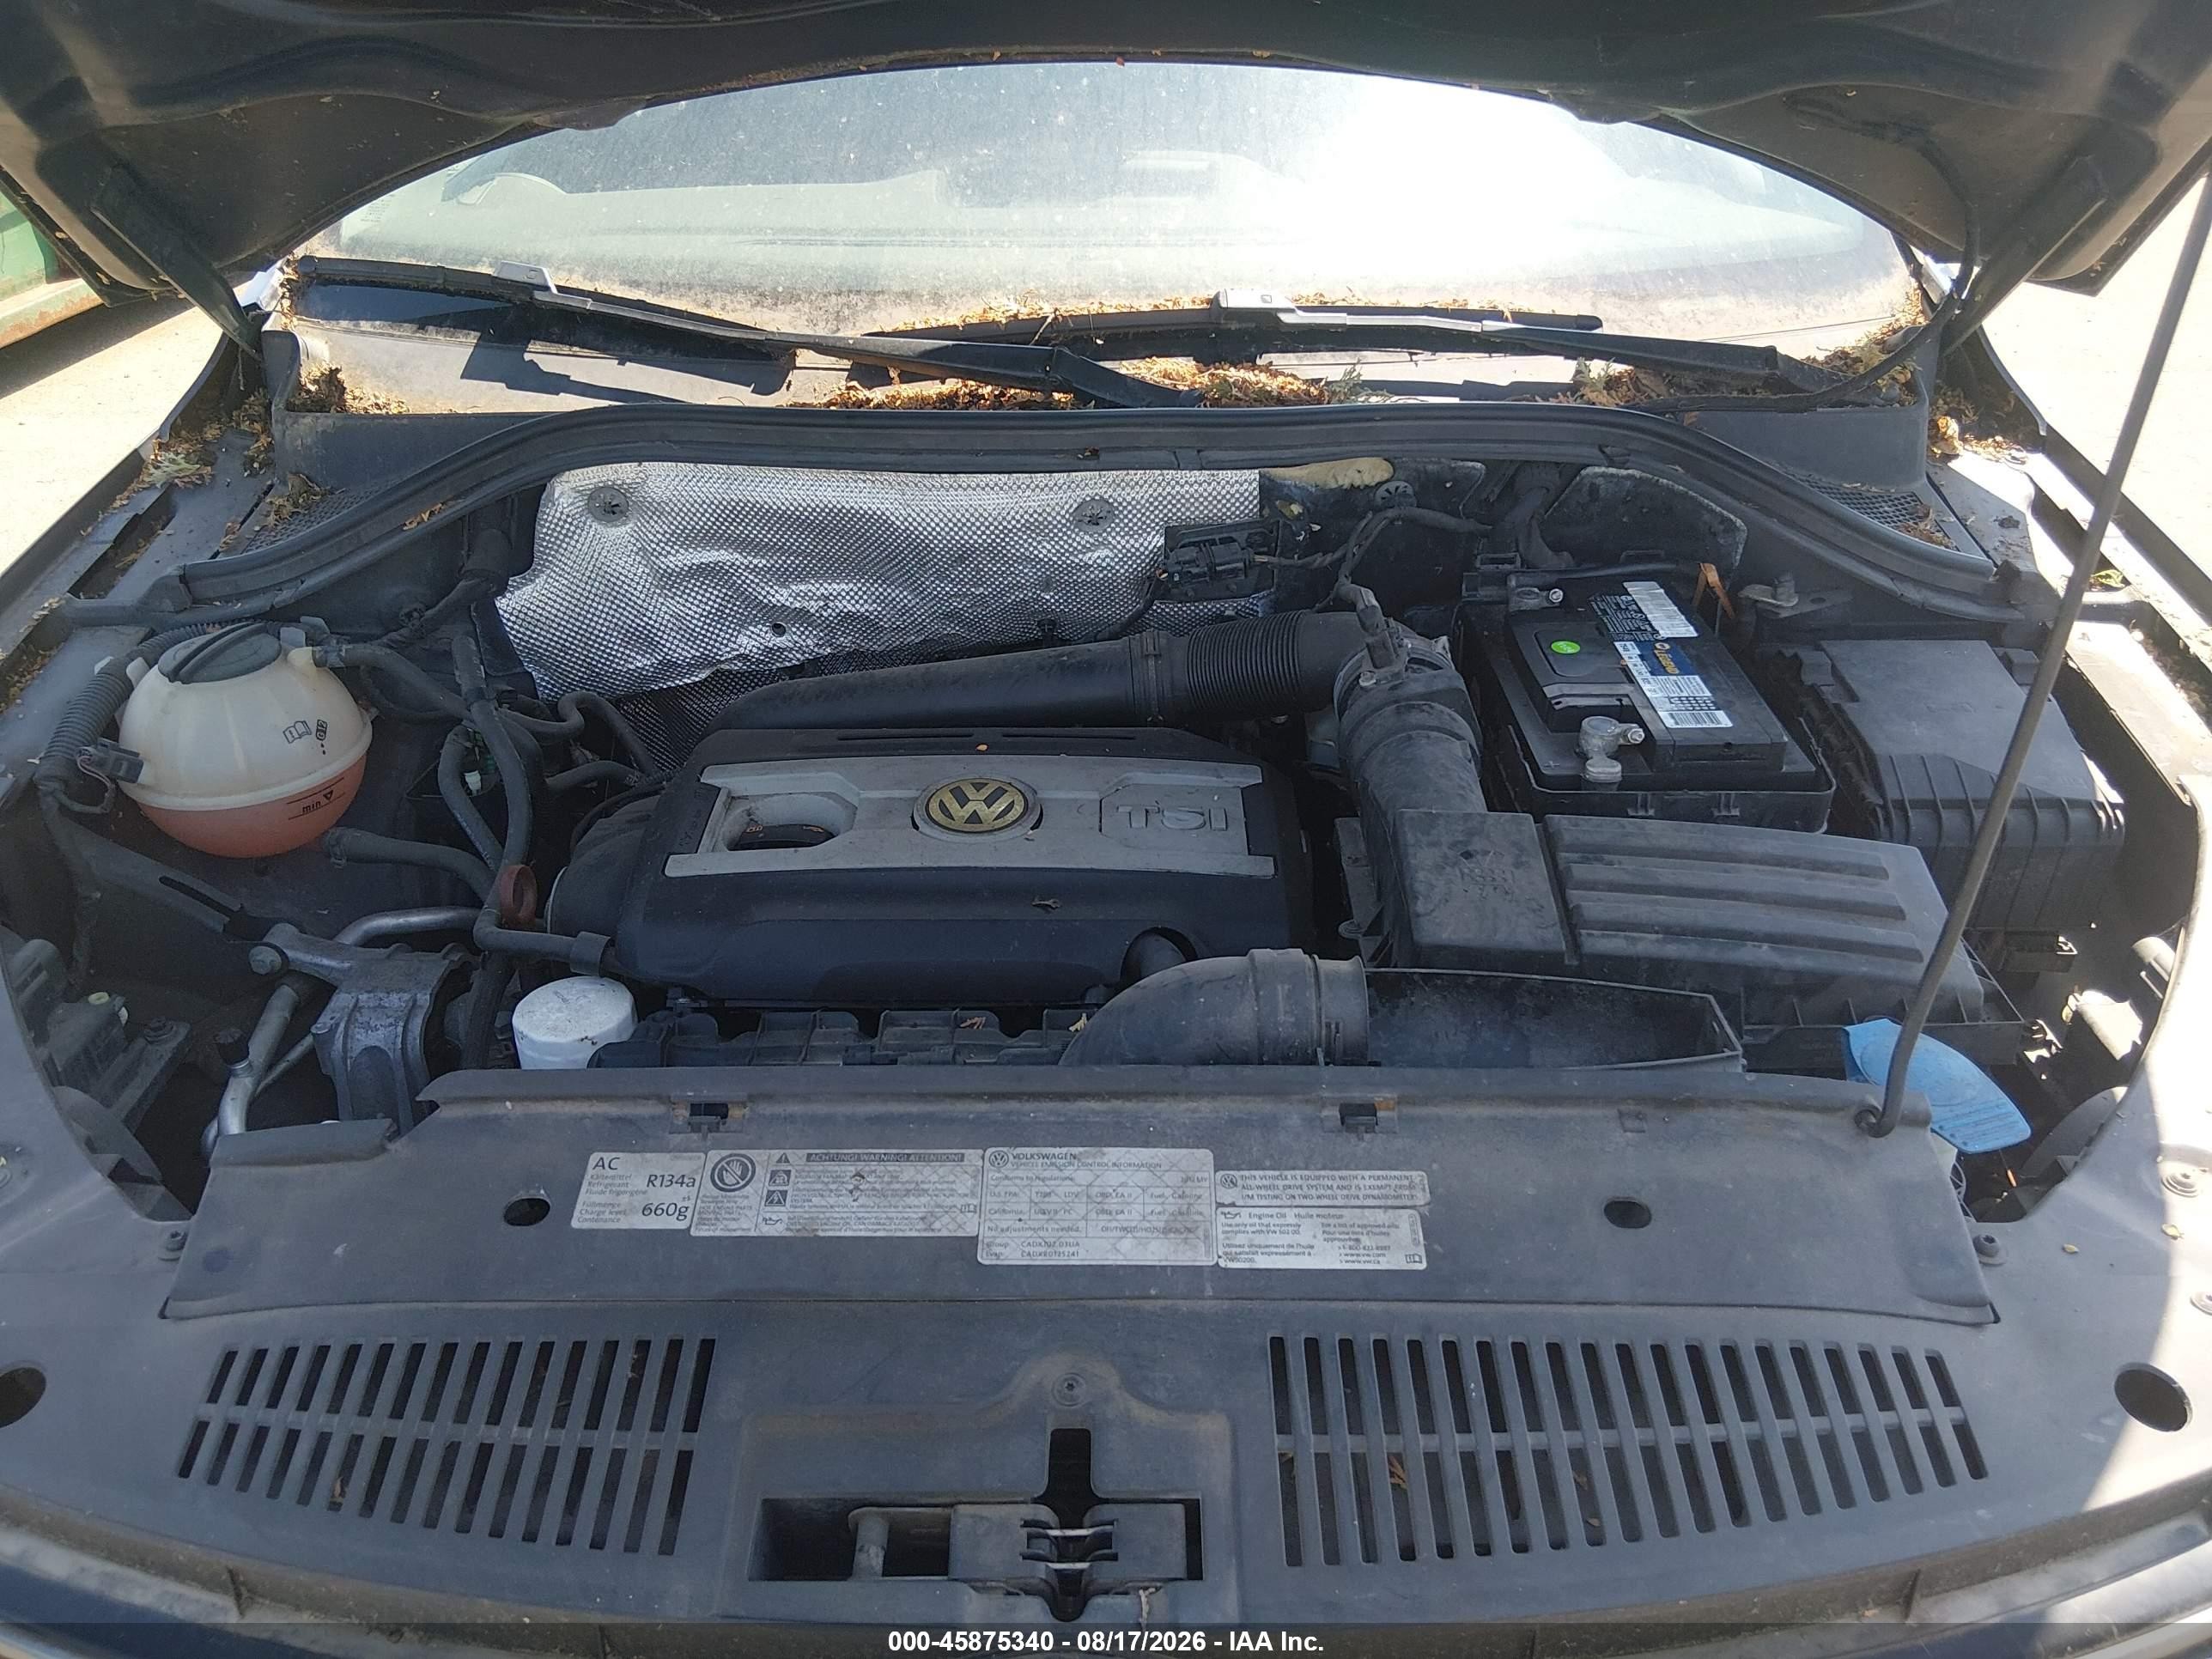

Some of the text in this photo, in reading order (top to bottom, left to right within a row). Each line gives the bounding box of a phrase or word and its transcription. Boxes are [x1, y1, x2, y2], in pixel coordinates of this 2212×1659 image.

[302, 801, 321, 814] min
[1118, 806, 1228, 832] TSI
[592, 1157, 620, 1170] AC
[647, 1174, 696, 1188] R134a
[641, 1202, 690, 1221] 660g
[1001, 1225, 1048, 1234] adjustments
